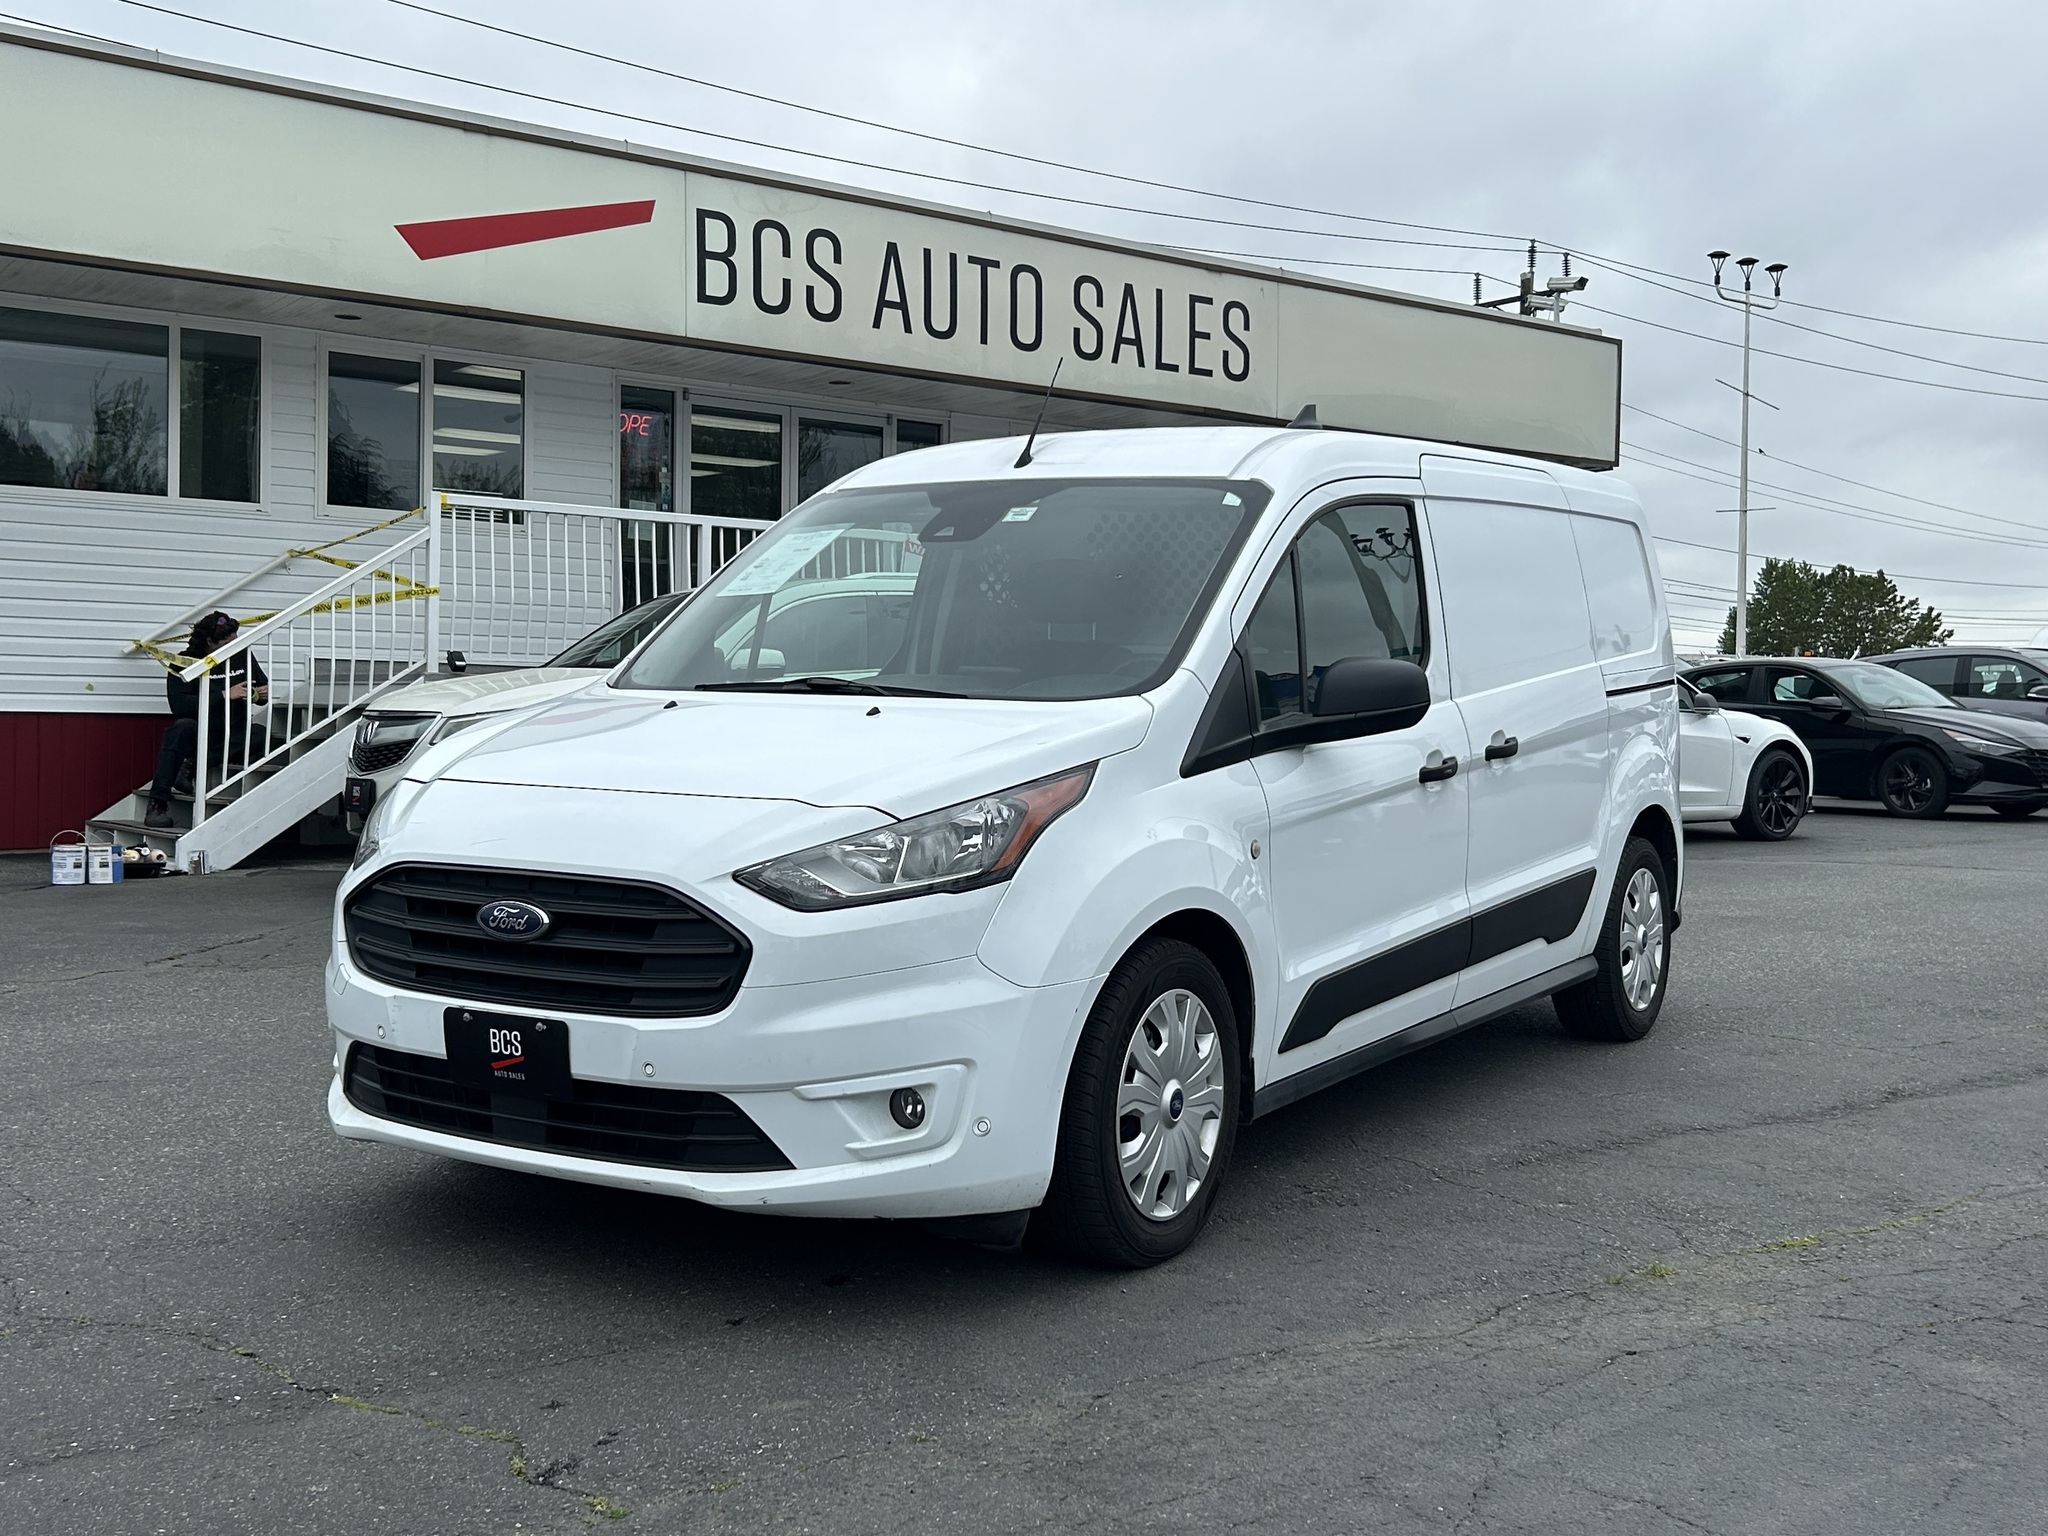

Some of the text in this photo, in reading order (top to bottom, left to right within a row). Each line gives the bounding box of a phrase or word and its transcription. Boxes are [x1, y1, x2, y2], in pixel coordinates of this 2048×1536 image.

[696, 208, 1251, 382] BCS AUTO SALES
[488, 906, 529, 930] Ford
[490, 1028, 522, 1056] BCS
